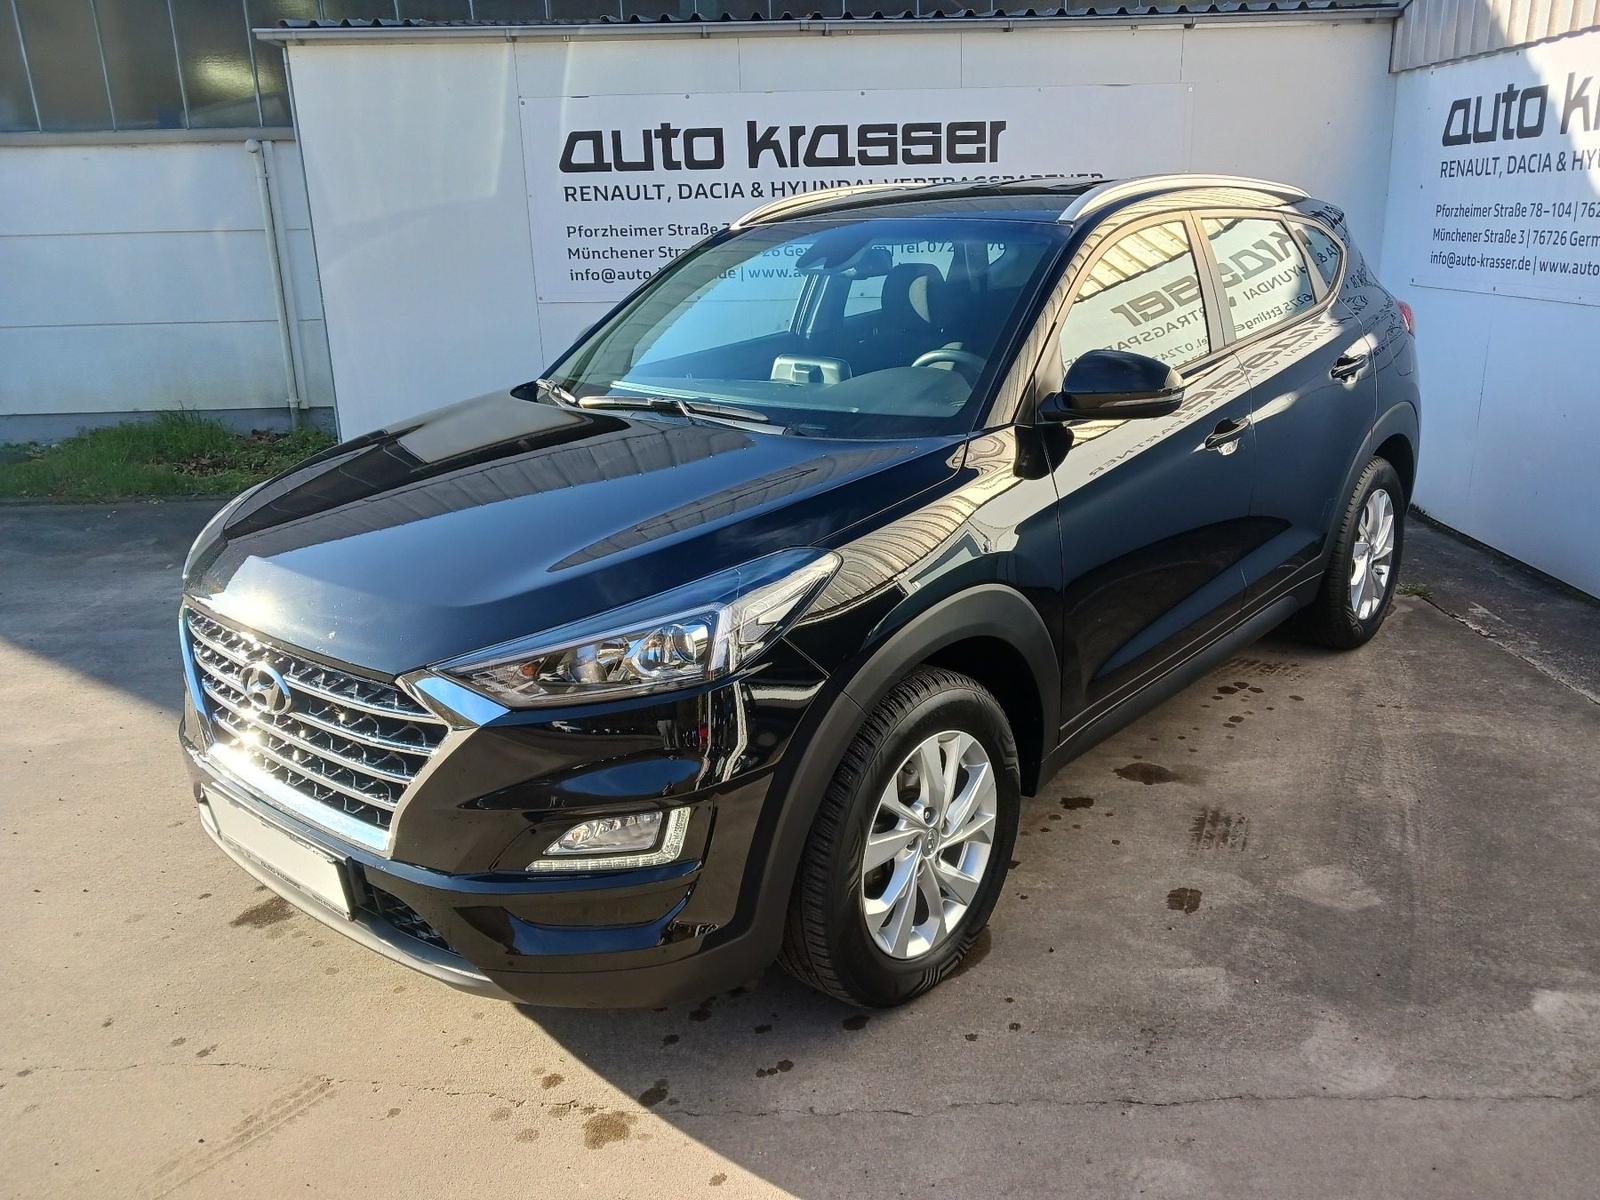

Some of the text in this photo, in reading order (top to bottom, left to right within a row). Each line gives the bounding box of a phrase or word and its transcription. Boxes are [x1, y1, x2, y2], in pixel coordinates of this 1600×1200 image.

[1442, 83, 1549, 146] auto
[559, 120, 1007, 173] auto krasser
[1440, 156, 1504, 179] RENAULT,
[1507, 152, 1552, 175] DACIA
[1556, 151, 1566, 172] &
[563, 183, 672, 203] RENAULT,
[677, 181, 744, 201] DACIA
[750, 181, 764, 198] &
[1435, 203, 1492, 218] Pforzheimer
[1493, 202, 1527, 218] Straße
[1581, 202, 1600, 218] 762
[566, 223, 664, 239] Pforzheimer
[667, 222, 718, 237] Straße
[1432, 228, 1482, 243] Münchener
[1484, 228, 1517, 244] Straße
[1518, 230, 1525, 244] 3
[1532, 230, 1567, 246] 76726
[568, 245, 655, 260] Münchener
[1430, 251, 1531, 272] info@auto-krasser.de
[1539, 259, 1600, 276] www.auto
